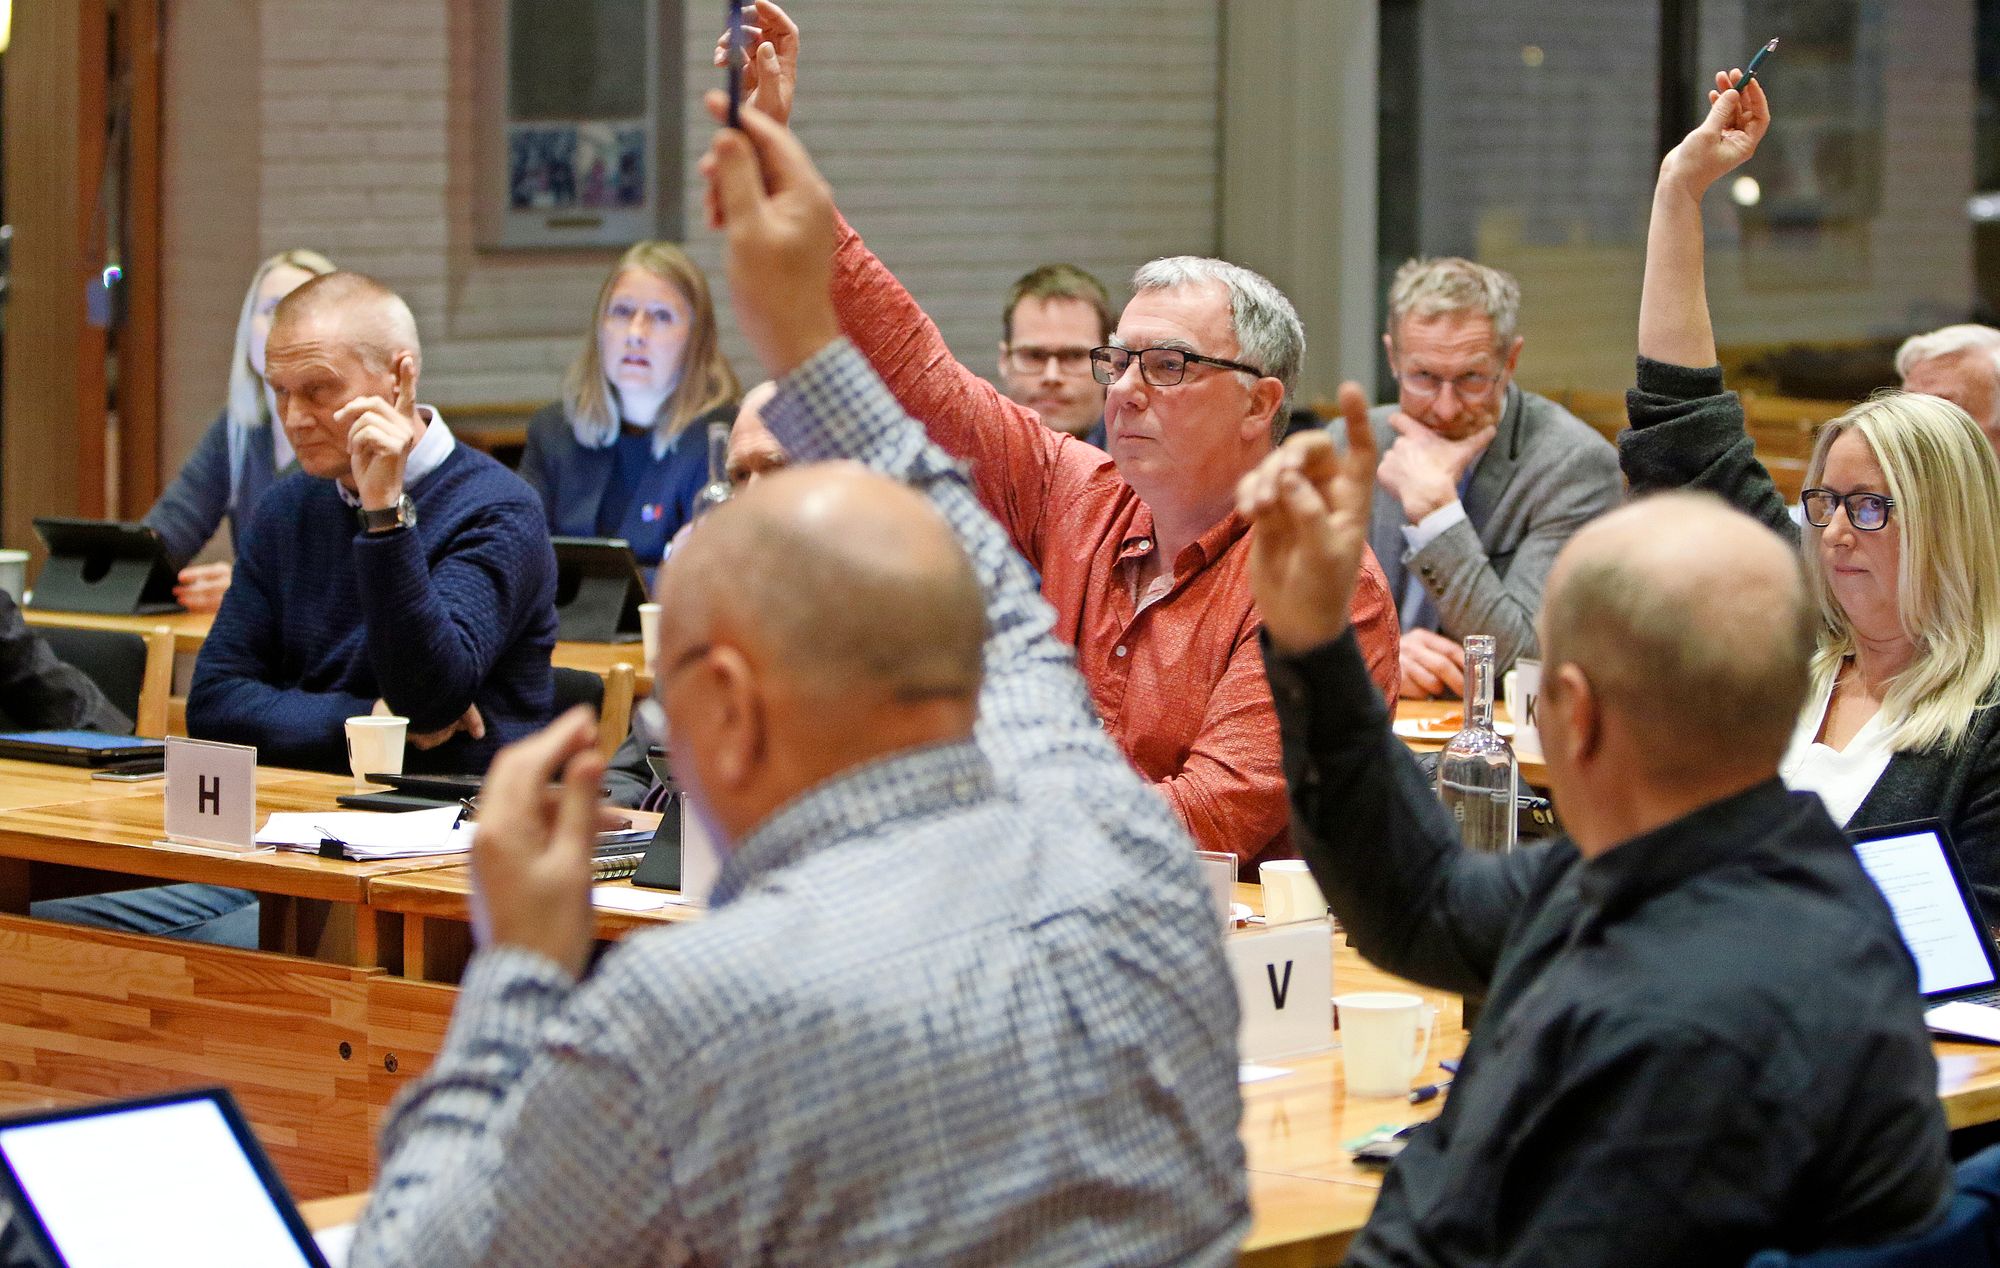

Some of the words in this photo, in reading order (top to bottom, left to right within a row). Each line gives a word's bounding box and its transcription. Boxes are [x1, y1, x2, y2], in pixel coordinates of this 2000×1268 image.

[1526, 693, 1538, 728] K
[199, 775, 220, 816] H
[1266, 960, 1293, 1010] V
